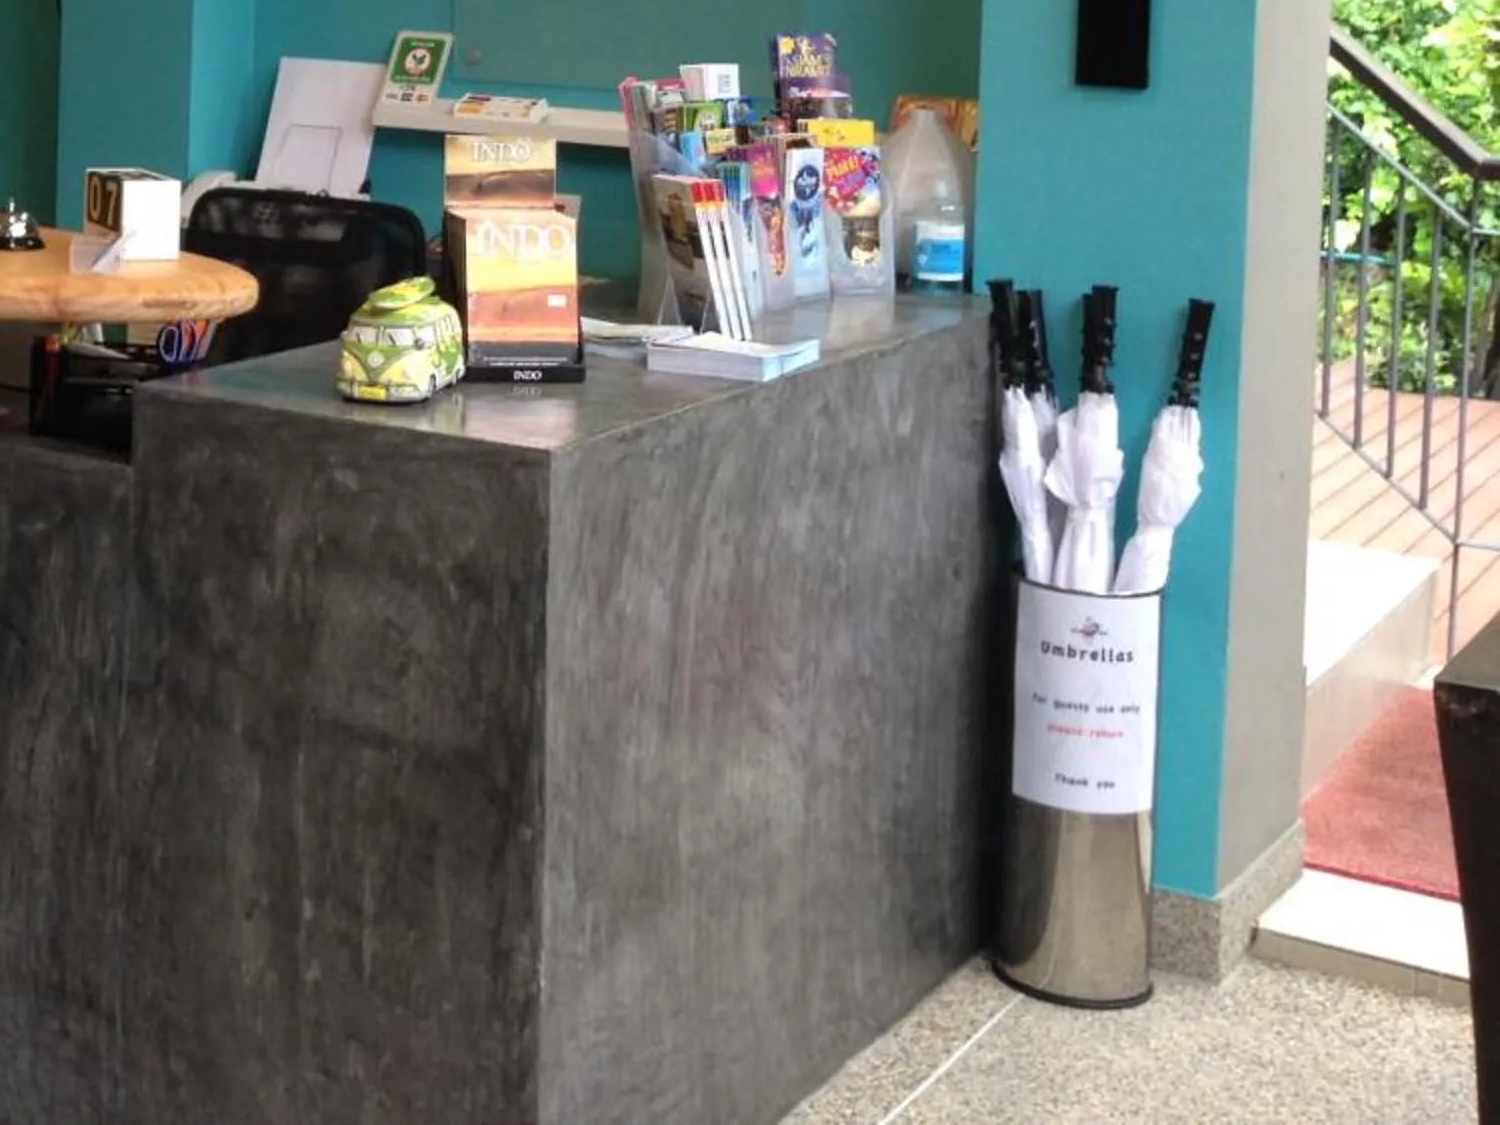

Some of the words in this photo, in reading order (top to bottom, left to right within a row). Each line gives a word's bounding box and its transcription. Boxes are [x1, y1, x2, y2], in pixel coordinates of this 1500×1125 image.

[471, 140, 532, 164] INDO
[476, 221, 573, 260] INDO
[513, 370, 543, 381] INDO
[1040, 639, 1135, 663] Umbrellas
